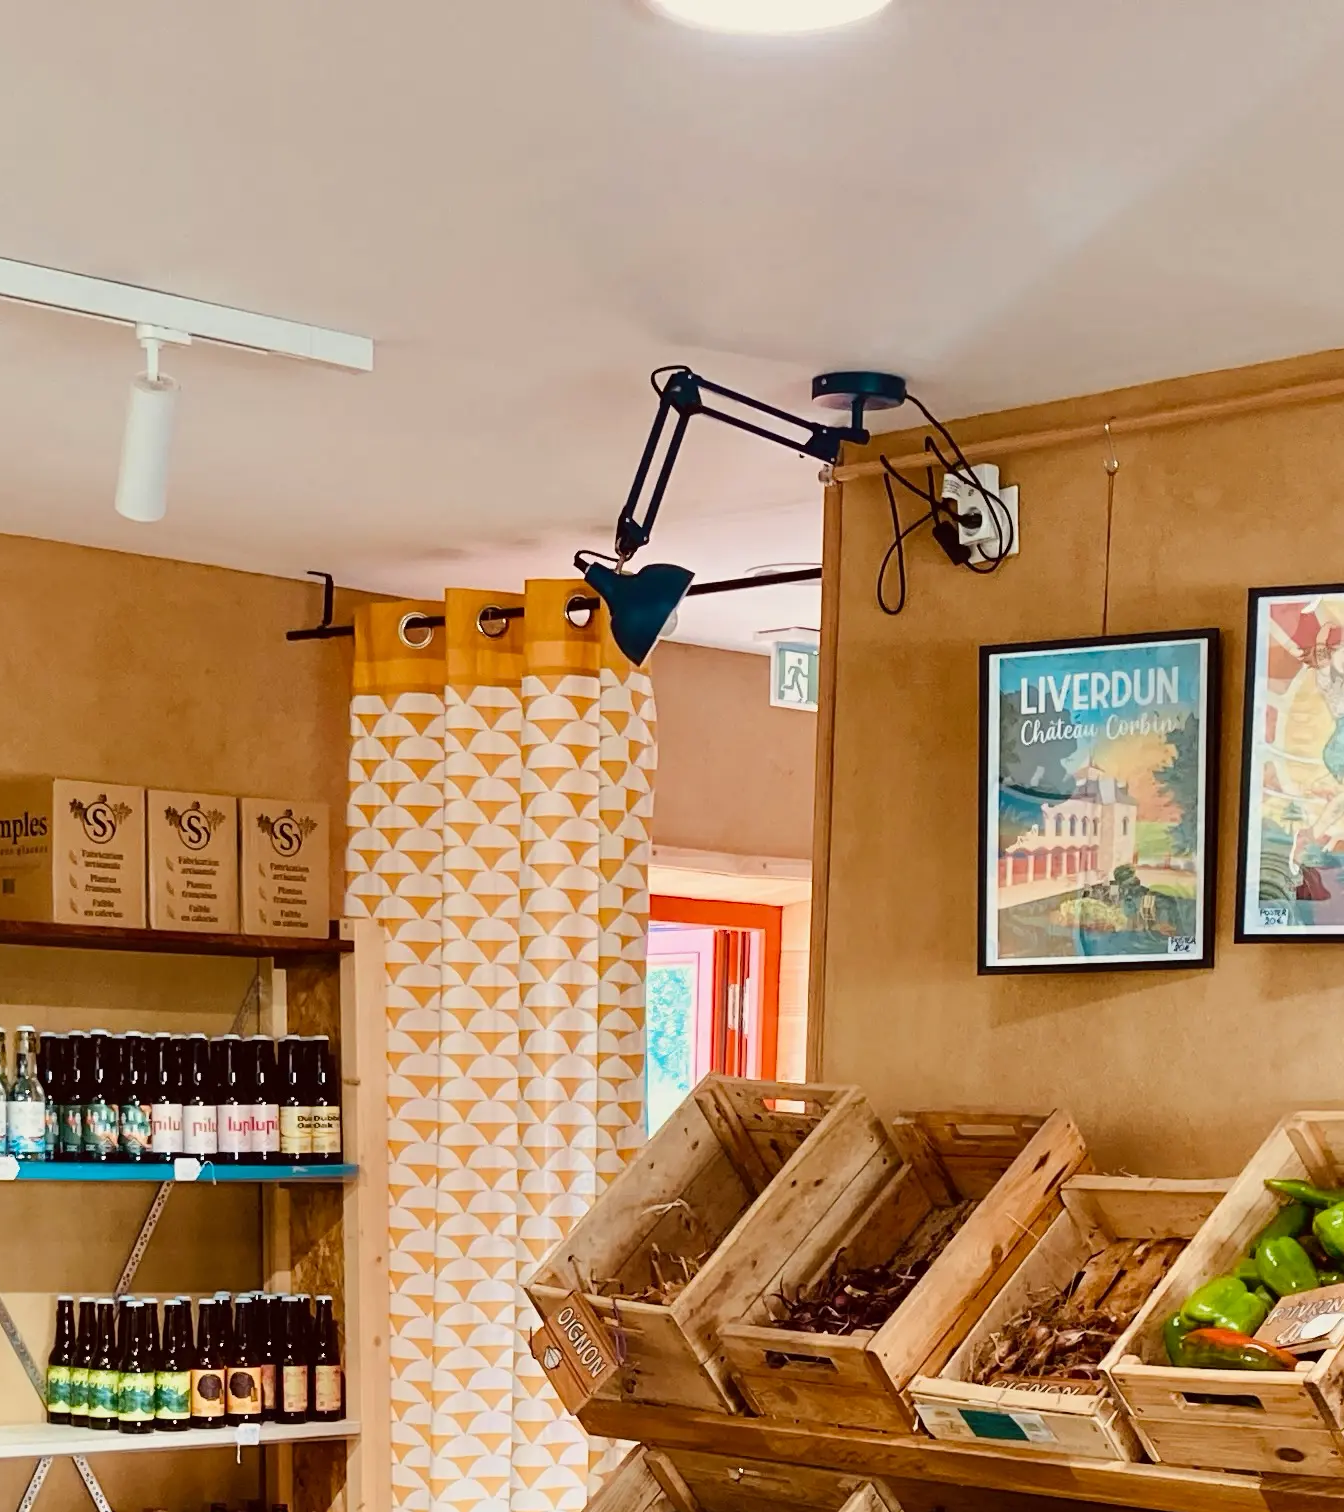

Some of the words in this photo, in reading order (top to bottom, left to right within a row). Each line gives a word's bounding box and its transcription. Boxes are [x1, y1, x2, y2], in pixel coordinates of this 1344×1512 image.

[1020, 666, 1179, 715] LIVERDUN
[1020, 718, 1098, 746] Château
[1106, 711, 1179, 741] Corbin
[1259, 908, 1287, 917] POSTER
